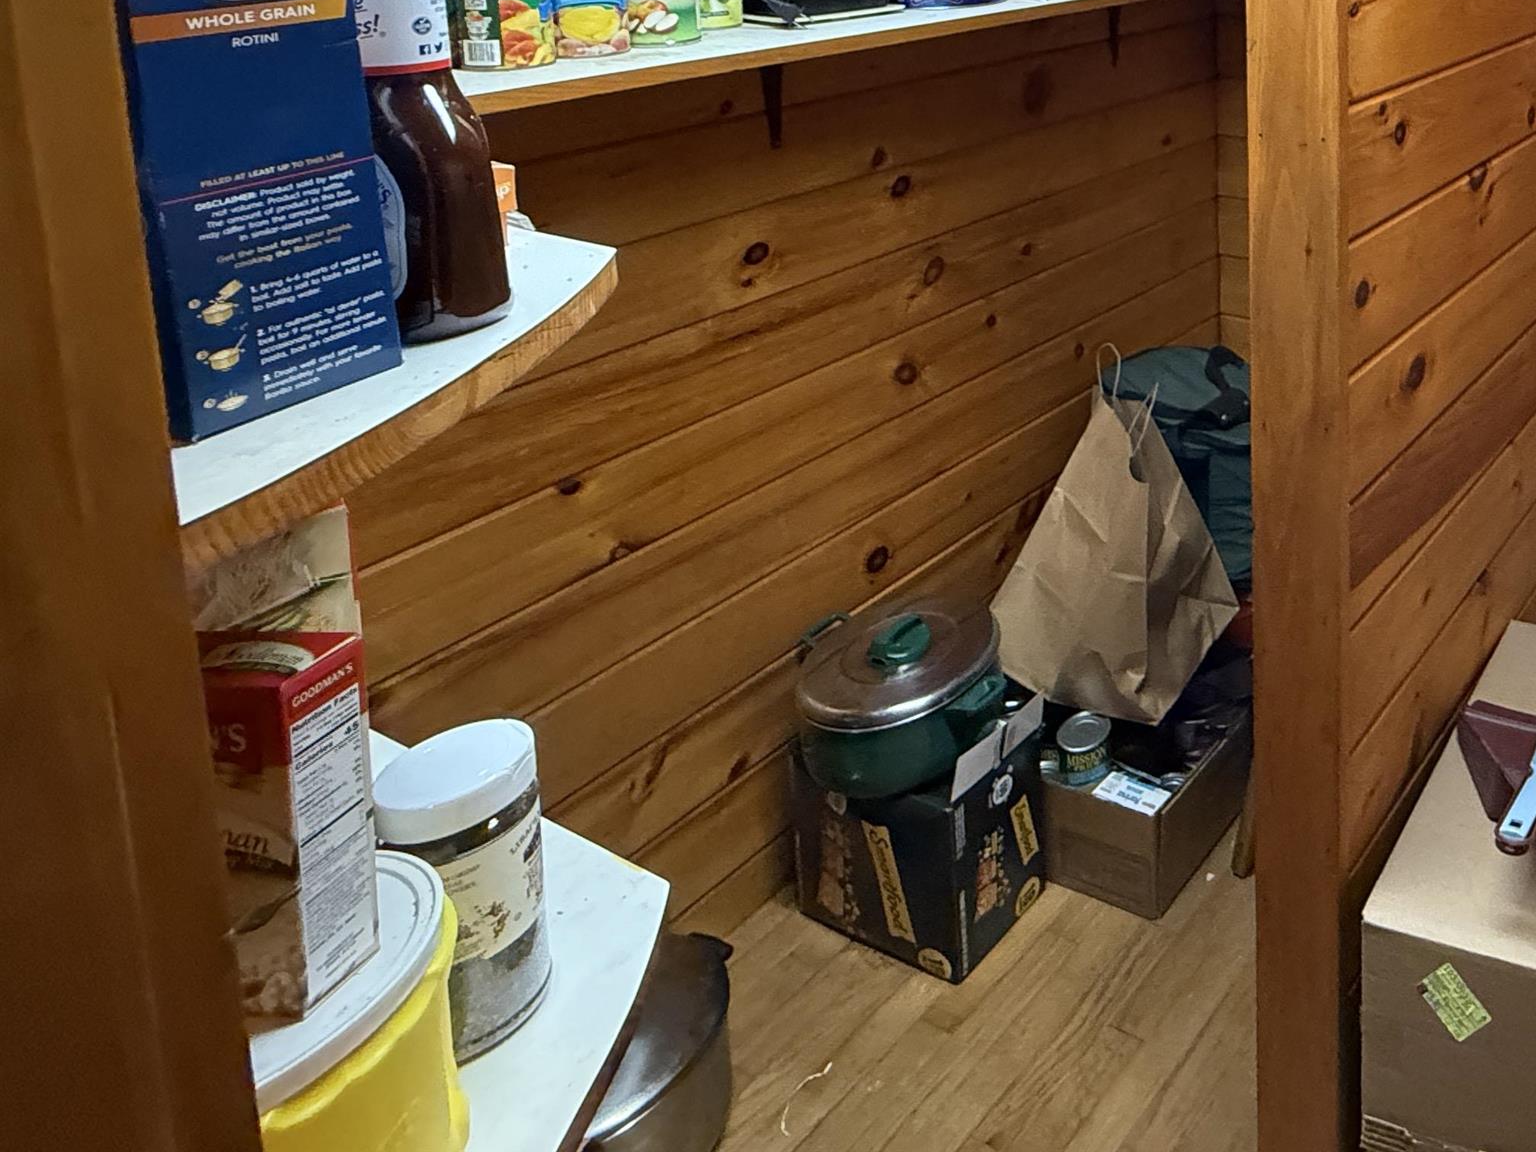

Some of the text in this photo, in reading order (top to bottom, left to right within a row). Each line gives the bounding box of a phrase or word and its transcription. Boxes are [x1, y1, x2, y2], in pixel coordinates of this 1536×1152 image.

[185, 4, 316, 30] WHOLE GRAIN
[231, 32, 280, 48] ROTINI
[201, 176, 232, 188] FILLED
[234, 173, 245, 181] AT
[248, 166, 275, 178] LEAST
[277, 163, 290, 172] UP
[305, 156, 324, 165] THIS
[326, 151, 344, 161] LINE
[292, 662, 353, 708] GOODMAN'S
[869, 828, 908, 936] Smartfood
